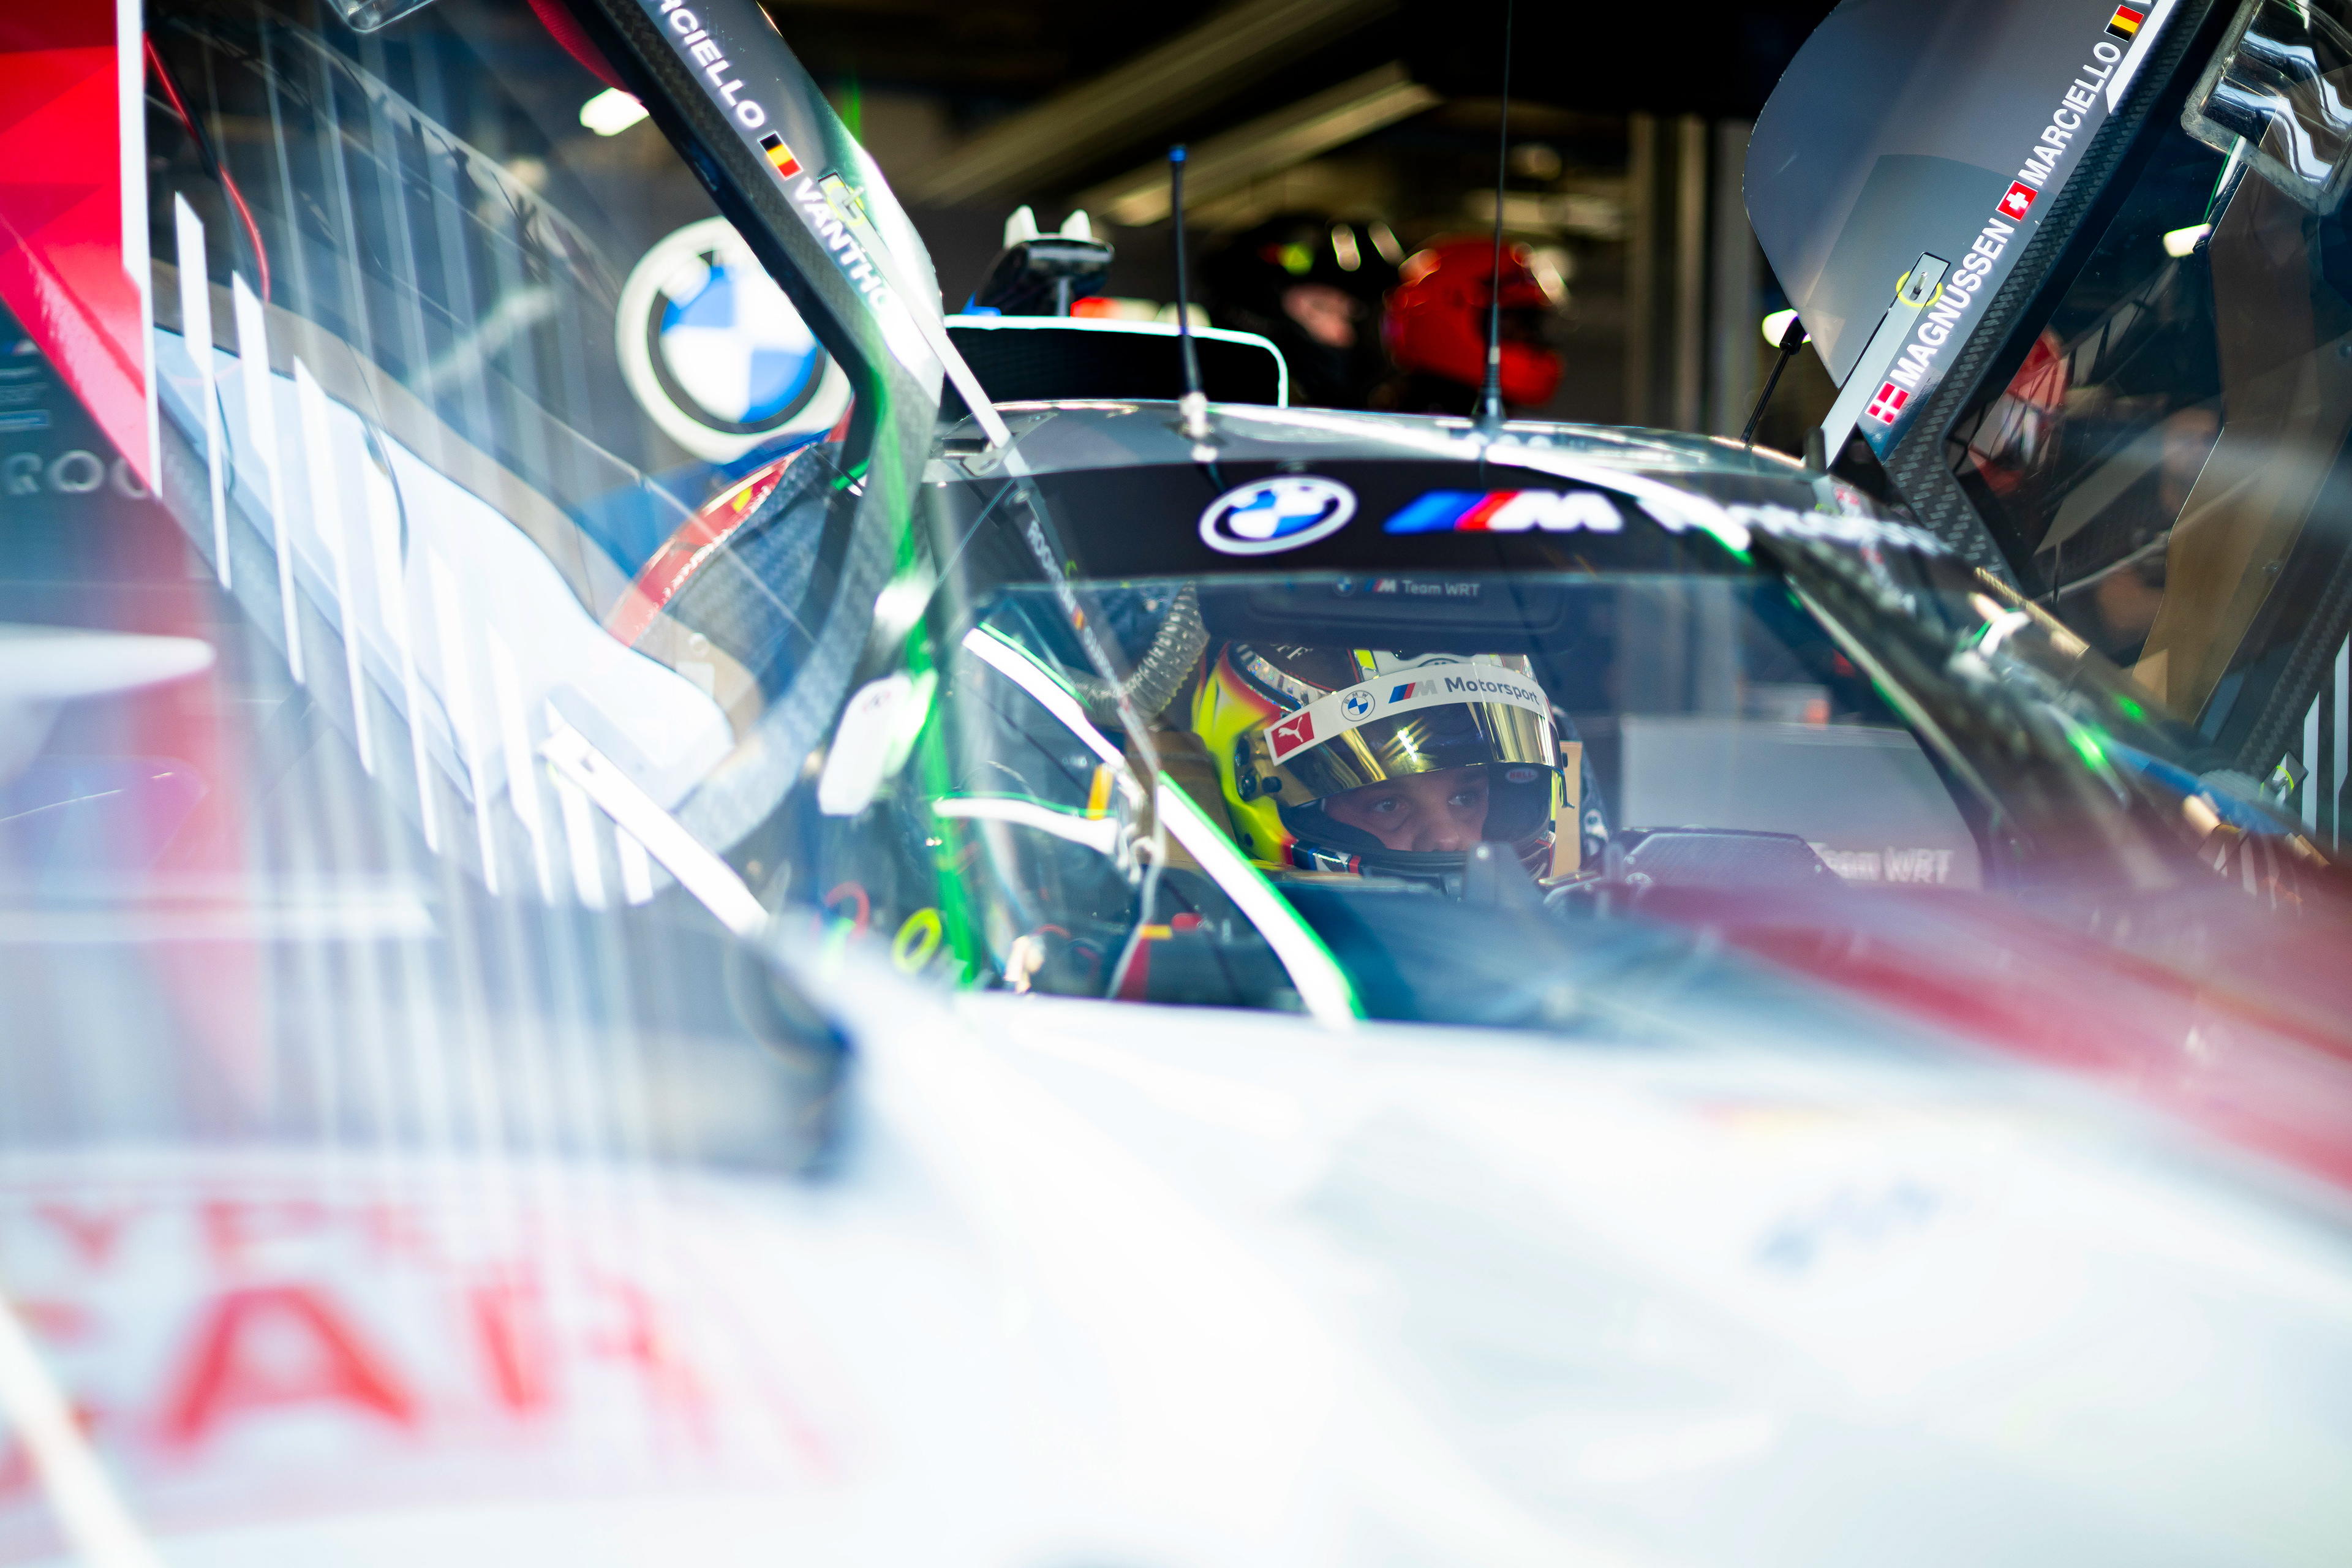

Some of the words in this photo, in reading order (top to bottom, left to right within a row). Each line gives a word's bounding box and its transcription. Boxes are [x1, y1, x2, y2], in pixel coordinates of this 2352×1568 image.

[2018, 42, 2120, 186] MARCIELLO
[1890, 217, 2015, 388] MAGNUSSEN
[1401, 579, 1441, 594] Team
[1444, 582, 1481, 597] WRT
[1444, 676, 1540, 705] Motorsport
